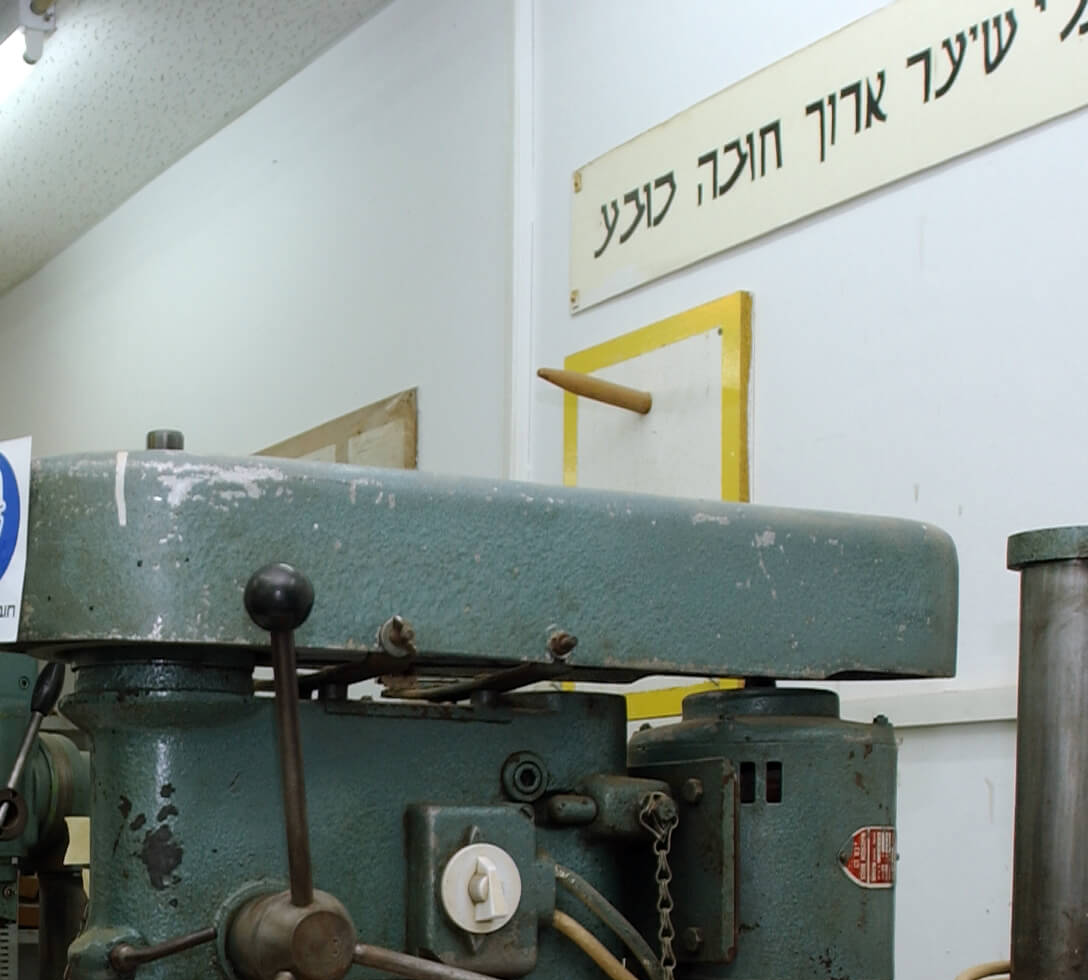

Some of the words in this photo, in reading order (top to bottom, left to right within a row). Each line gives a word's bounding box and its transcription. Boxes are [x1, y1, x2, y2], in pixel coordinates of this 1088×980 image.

[906, 7, 1019, 104] שיער
[805, 69, 888, 163] ארוך
[696, 118, 783, 207] חובה
[593, 170, 677, 259] כובע
